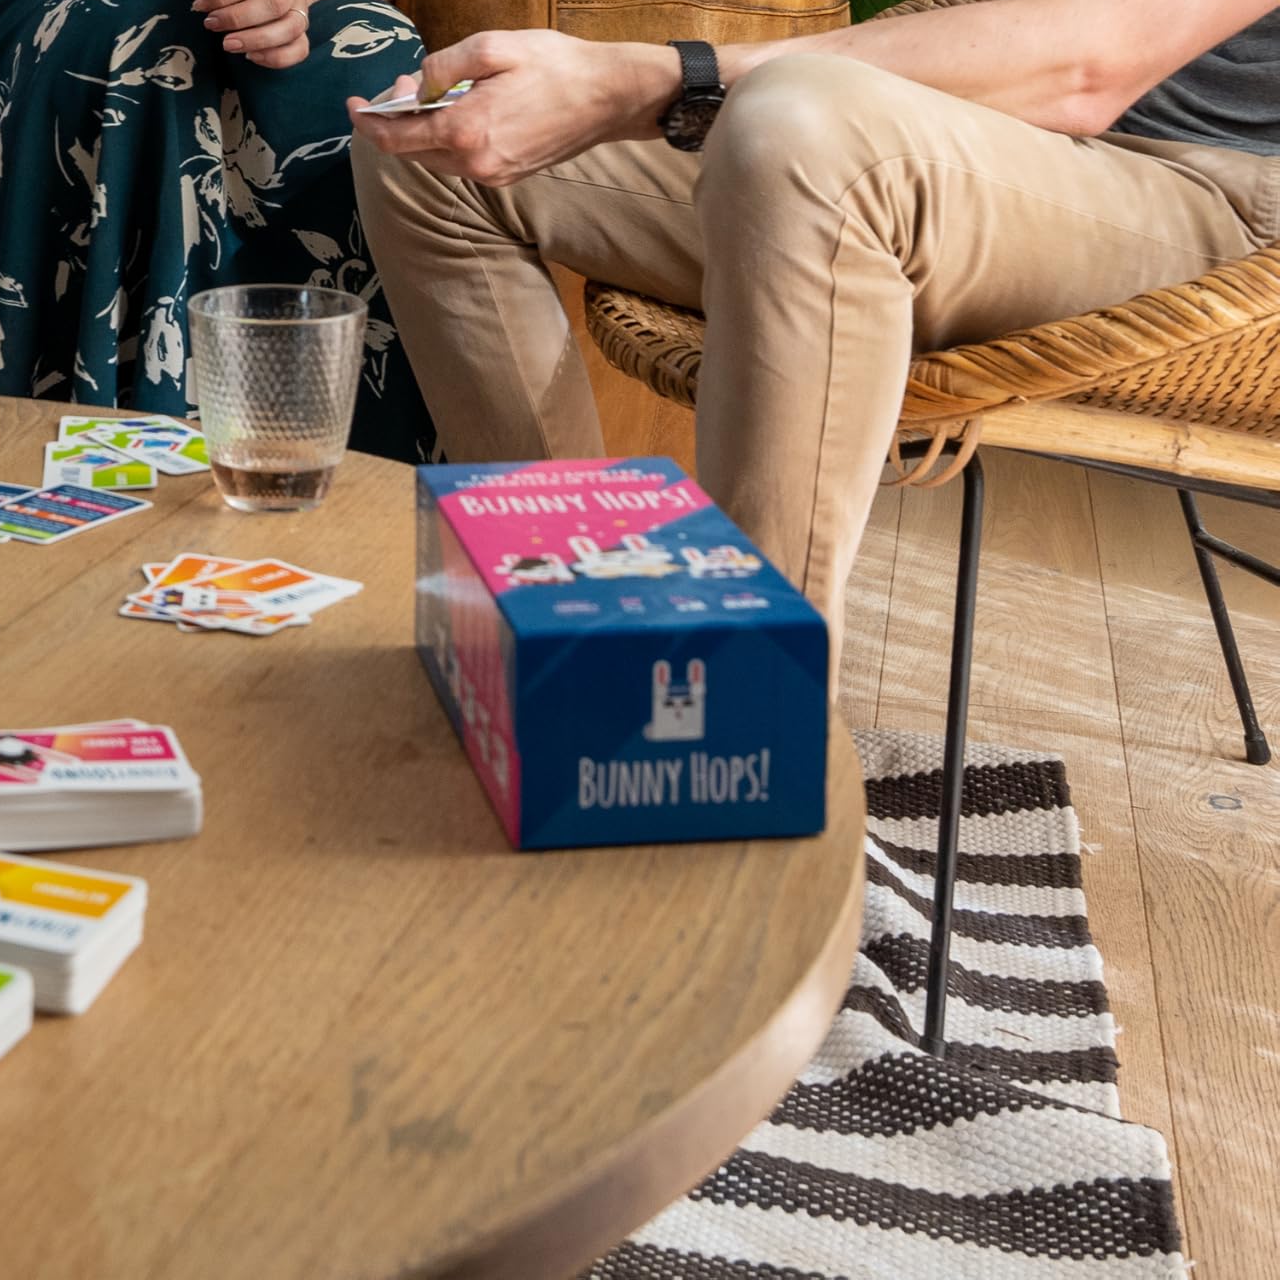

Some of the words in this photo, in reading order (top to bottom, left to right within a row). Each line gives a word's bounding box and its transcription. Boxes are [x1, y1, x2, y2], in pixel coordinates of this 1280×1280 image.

[458, 492, 588, 517] BUNNY
[591, 486, 699, 512] HOPS!
[578, 756, 683, 810] BUNNY
[689, 747, 771, 805] HOPS!
